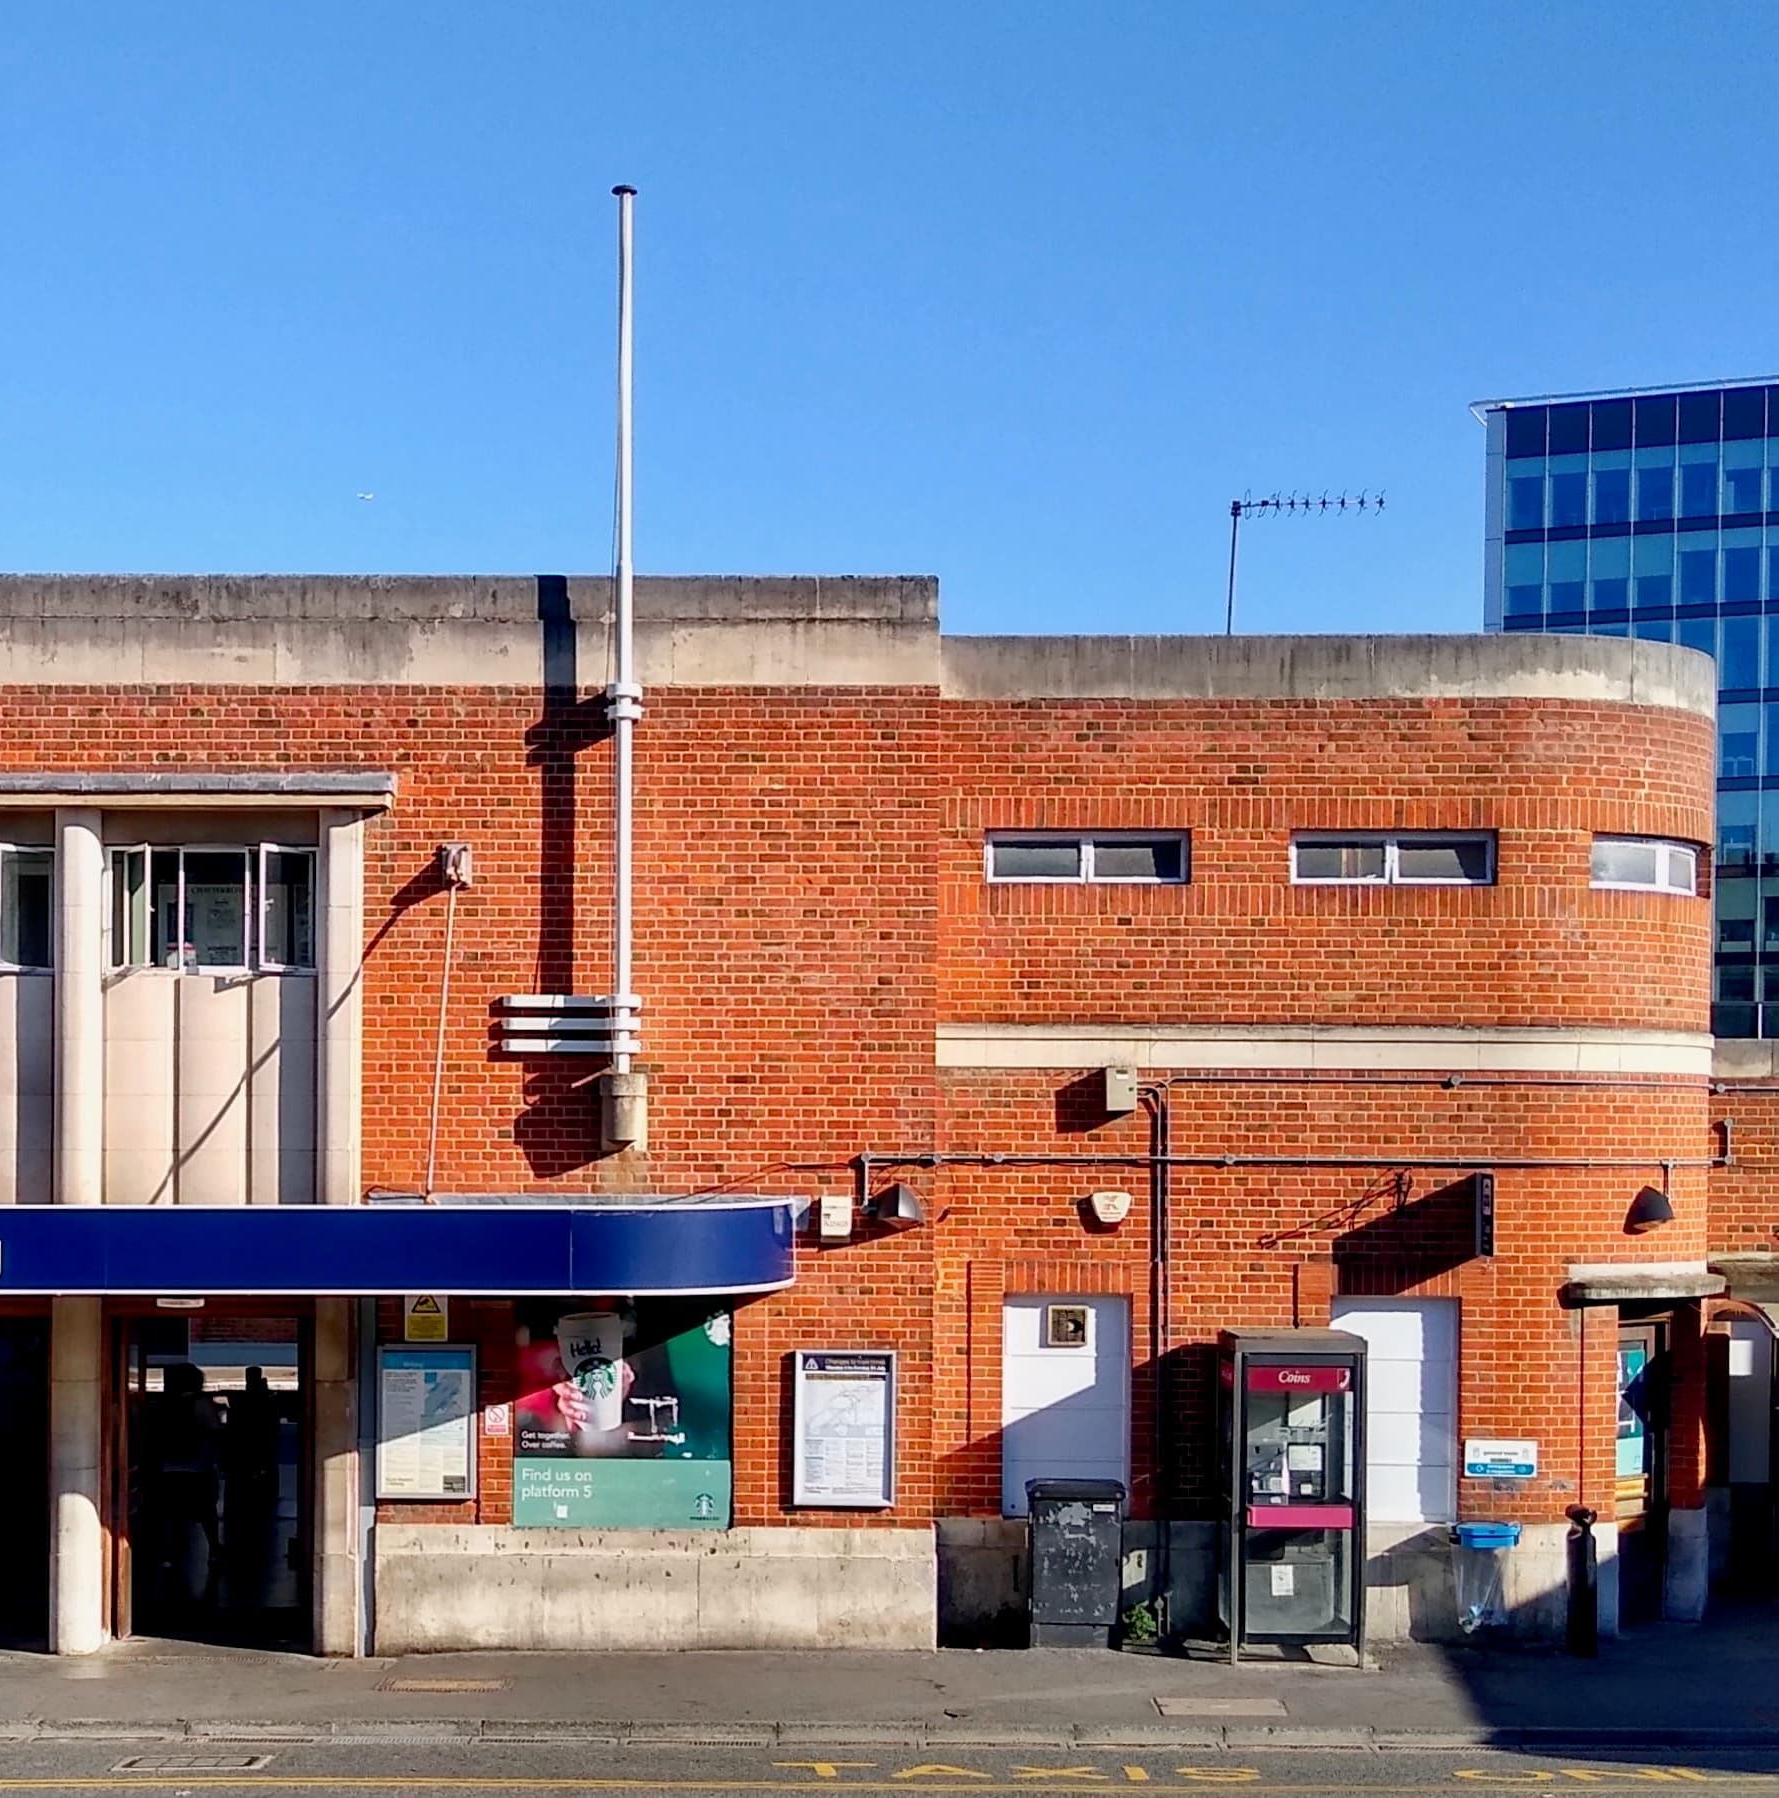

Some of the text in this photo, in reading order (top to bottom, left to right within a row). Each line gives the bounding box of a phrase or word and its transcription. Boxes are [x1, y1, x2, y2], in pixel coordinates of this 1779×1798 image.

[1278, 1370, 1311, 1384] Coins
[521, 1431, 571, 1441] Get together.
[521, 1440, 540, 1448] Over
[522, 1467, 592, 1481] Find us on
[522, 1484, 592, 1501] platform 5
[772, 1761, 1262, 1781] TAXIS
